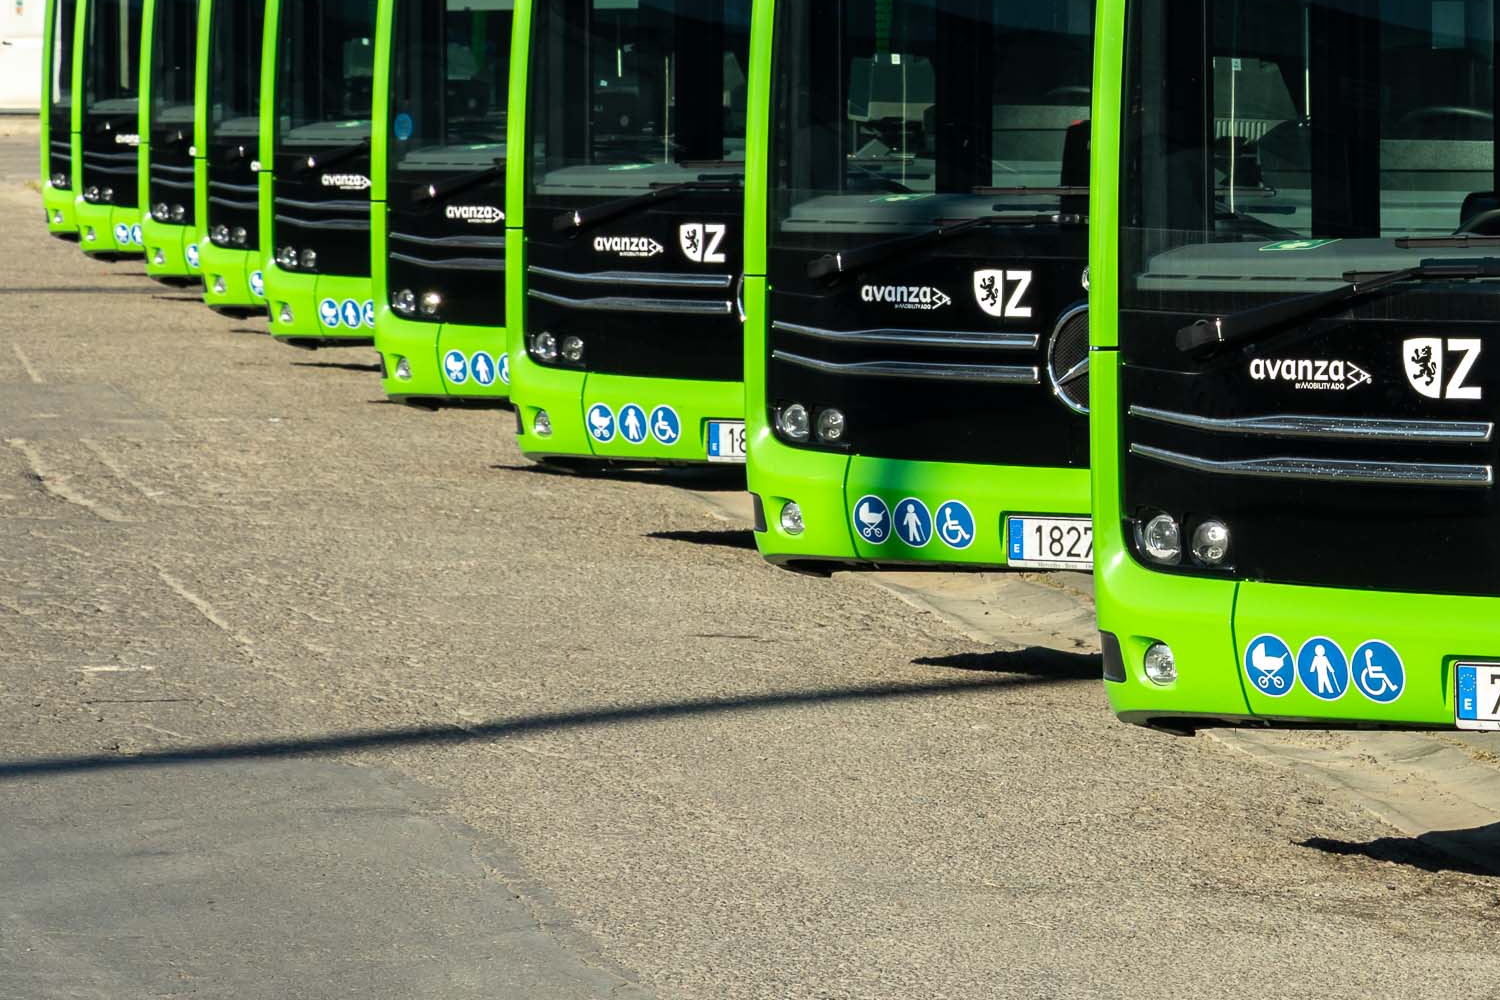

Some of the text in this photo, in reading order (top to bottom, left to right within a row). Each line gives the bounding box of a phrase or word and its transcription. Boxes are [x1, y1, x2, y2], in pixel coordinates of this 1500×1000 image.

[321, 173, 361, 187] avanza
[446, 205, 493, 219] avanza
[593, 236, 649, 252] avanza
[861, 284, 932, 304] avanza
[1249, 357, 1345, 382] avanza
[1301, 382, 1331, 390] MOBILITY
[1035, 525, 1094, 558] 1827
[1463, 698, 1473, 711] E
